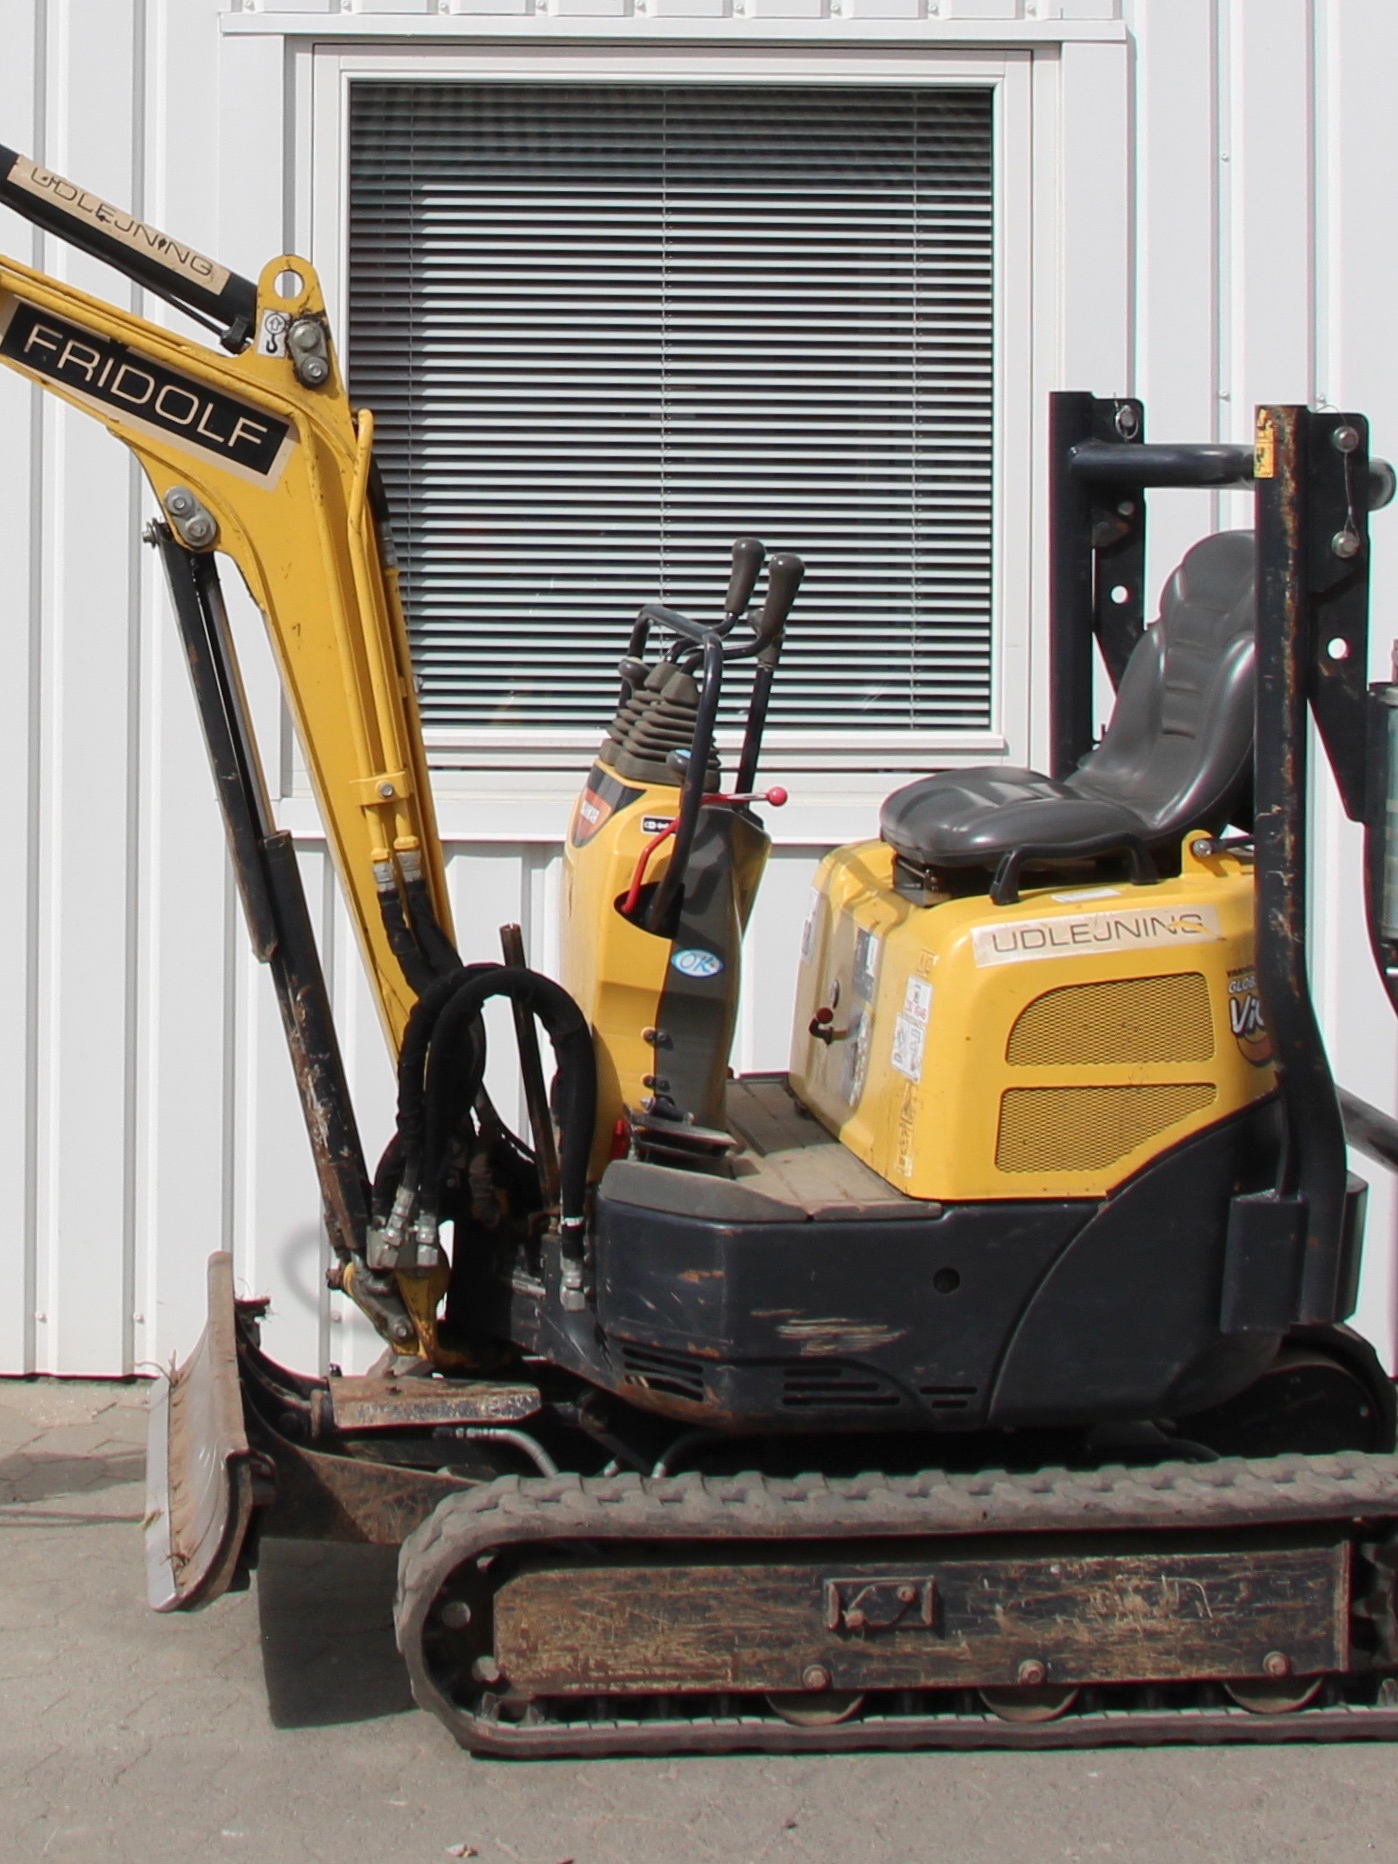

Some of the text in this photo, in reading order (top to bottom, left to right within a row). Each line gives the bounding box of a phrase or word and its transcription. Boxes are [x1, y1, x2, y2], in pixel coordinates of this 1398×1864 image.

[30, 165, 215, 277] UDLEJNING
[23, 322, 268, 448] FRIDOLF
[679, 951, 715, 973] OK
[992, 913, 1204, 954] UDLEJNING
